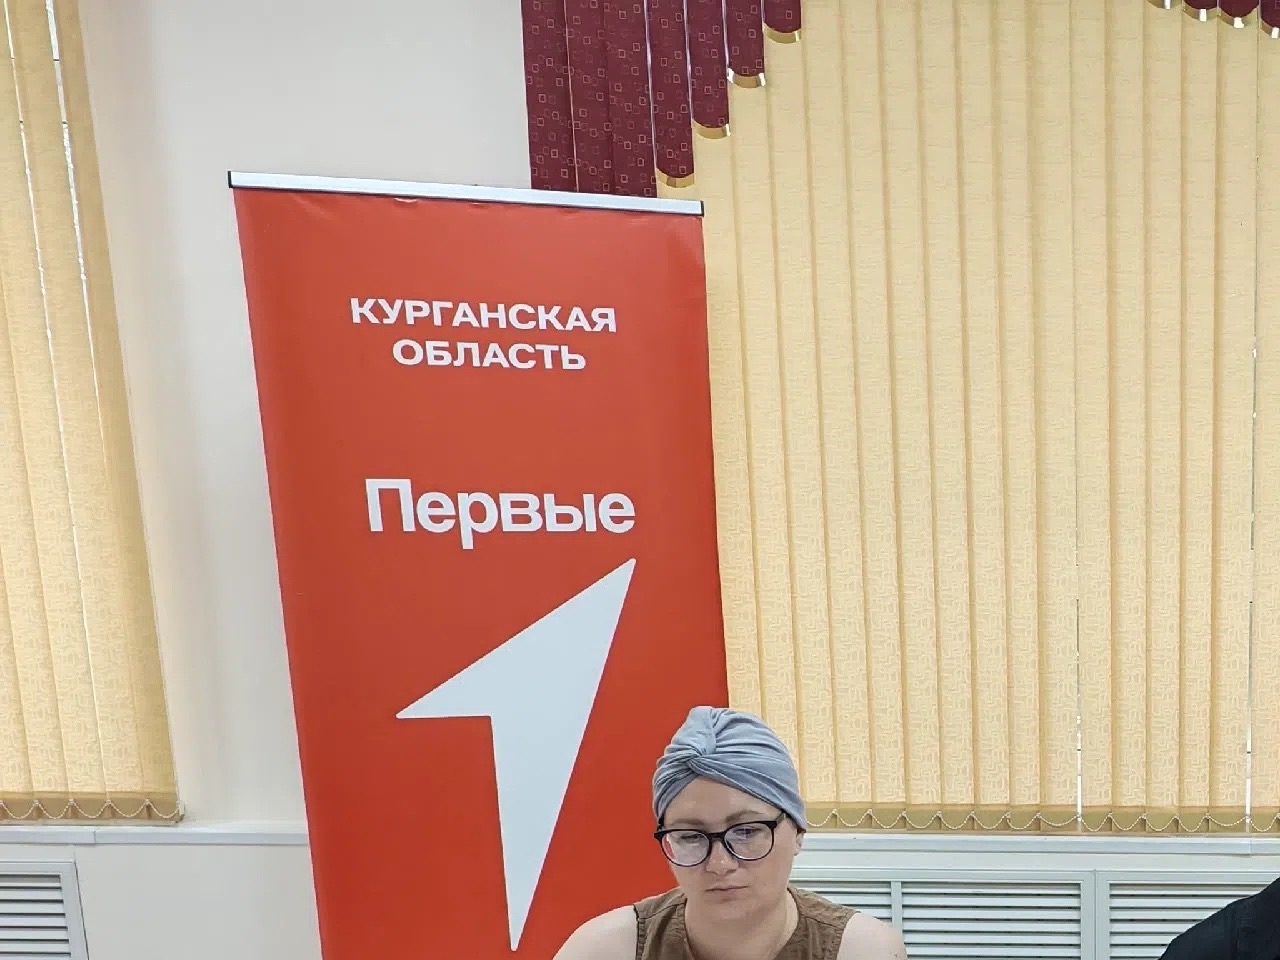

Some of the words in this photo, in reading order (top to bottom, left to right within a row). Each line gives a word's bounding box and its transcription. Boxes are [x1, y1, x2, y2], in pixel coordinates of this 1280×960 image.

[350, 297, 617, 332] КУРГАНСКАЯ
[392, 338, 586, 370] ОБЛАСТЬ
[365, 478, 636, 550] Первые
